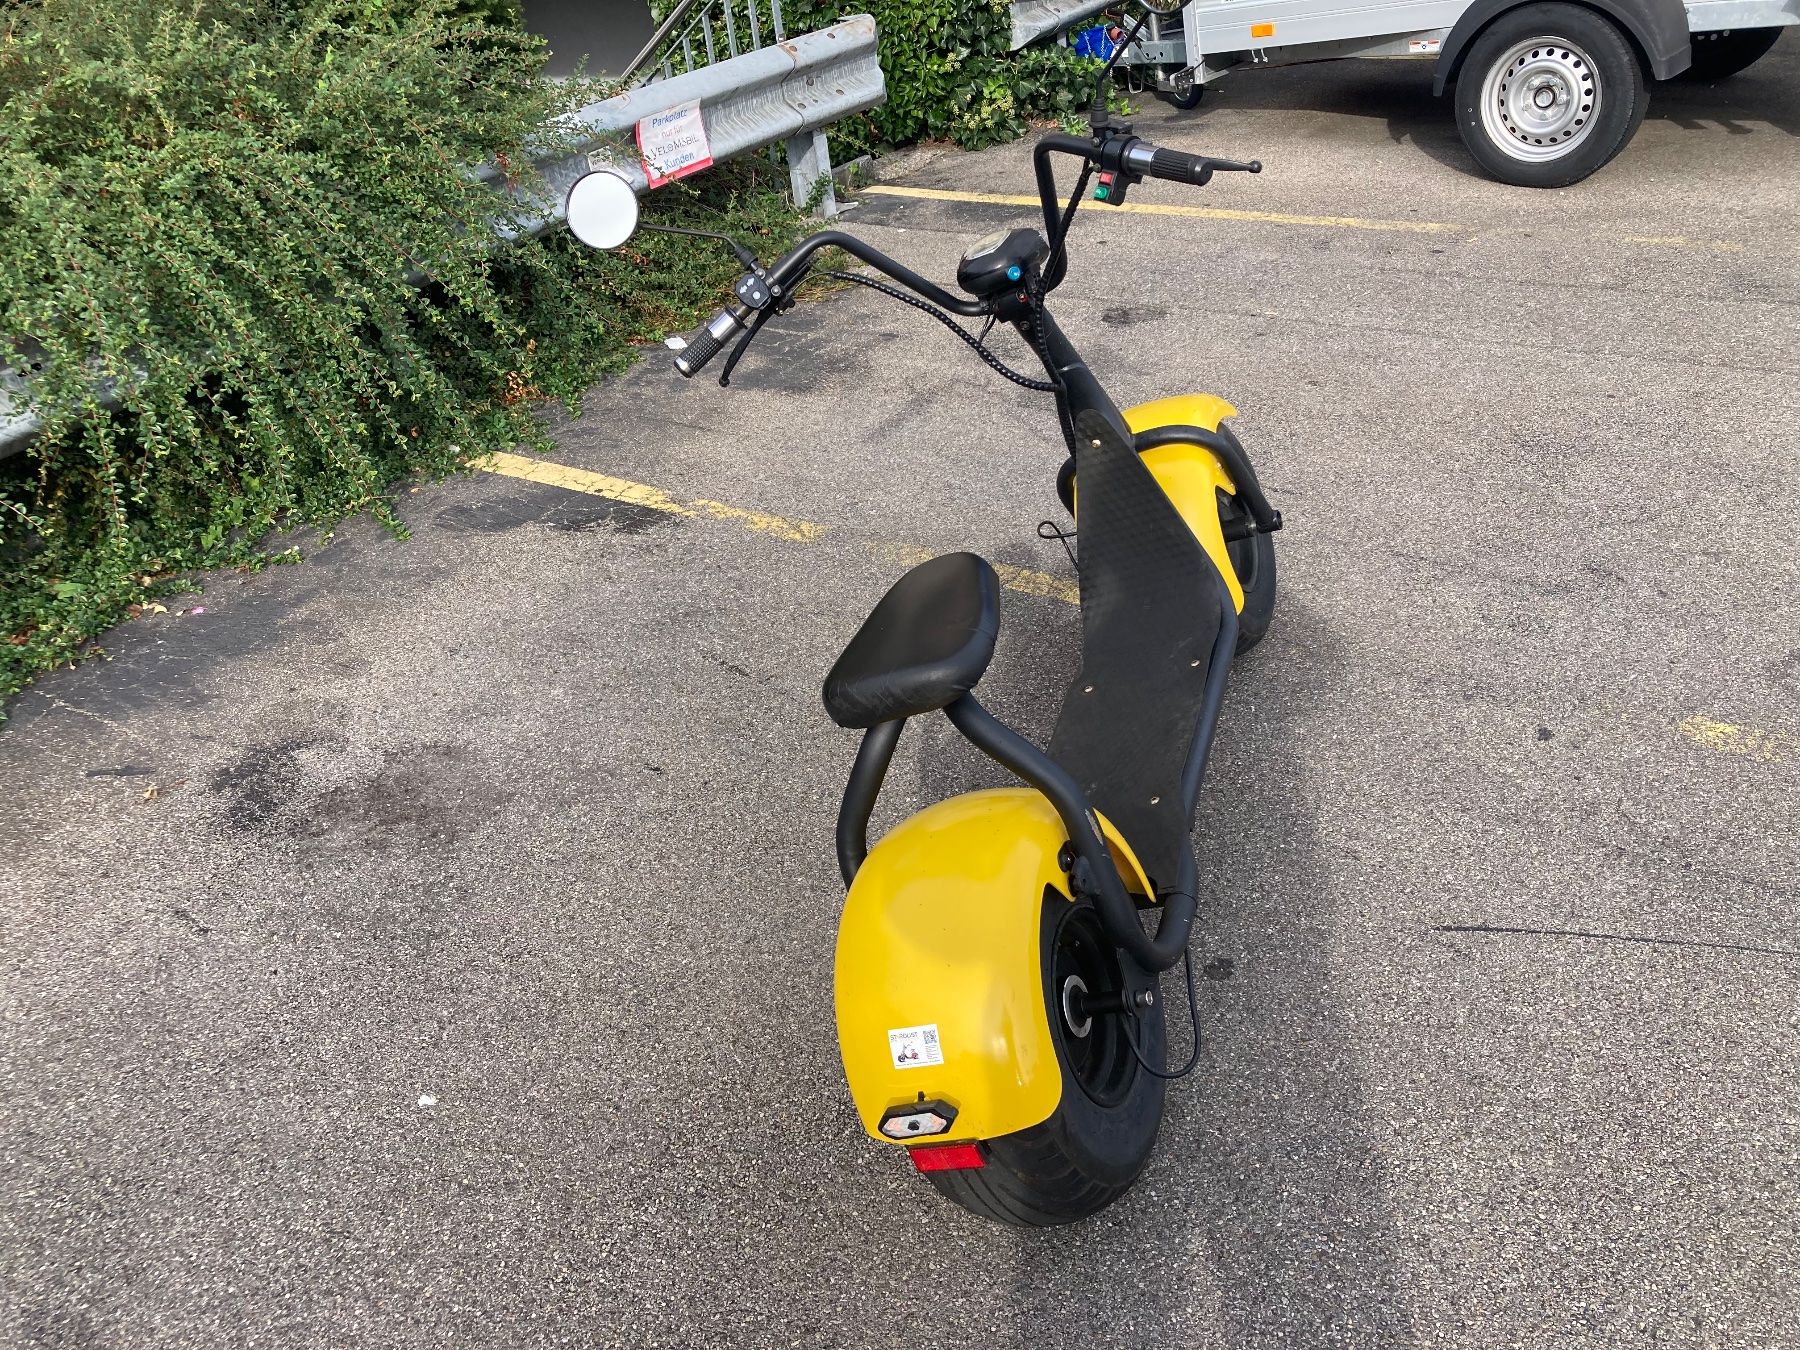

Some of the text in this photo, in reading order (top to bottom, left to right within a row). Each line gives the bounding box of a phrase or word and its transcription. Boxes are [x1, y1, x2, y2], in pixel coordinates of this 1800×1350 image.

[652, 108, 688, 128] Parkplatz
[661, 127, 673, 138] nur
[663, 151, 695, 170] Kunden
[889, 1031, 918, 1041] STRDUST
